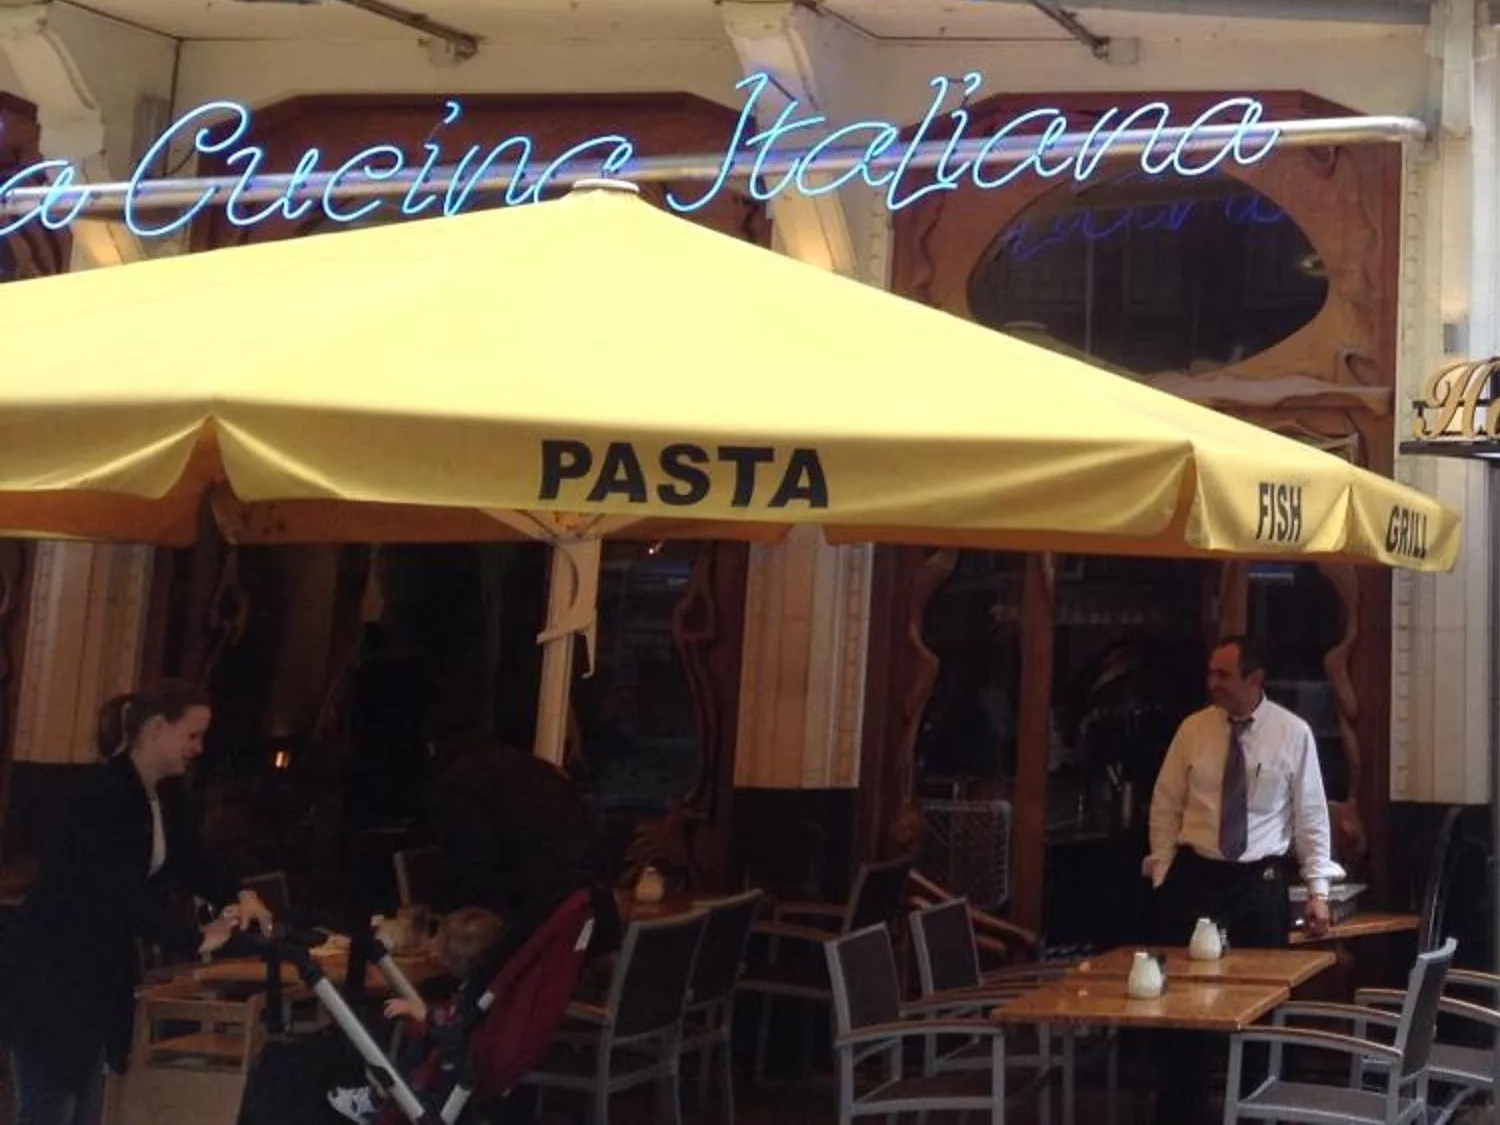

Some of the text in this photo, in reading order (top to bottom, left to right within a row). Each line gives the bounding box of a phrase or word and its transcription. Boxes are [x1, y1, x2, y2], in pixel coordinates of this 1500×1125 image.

[124, 100, 634, 237] Cucina
[666, 71, 1282, 212] Italiana
[538, 439, 829, 509] PASTA
[1256, 482, 1304, 543] FISH
[1385, 505, 1428, 560] GRILL
